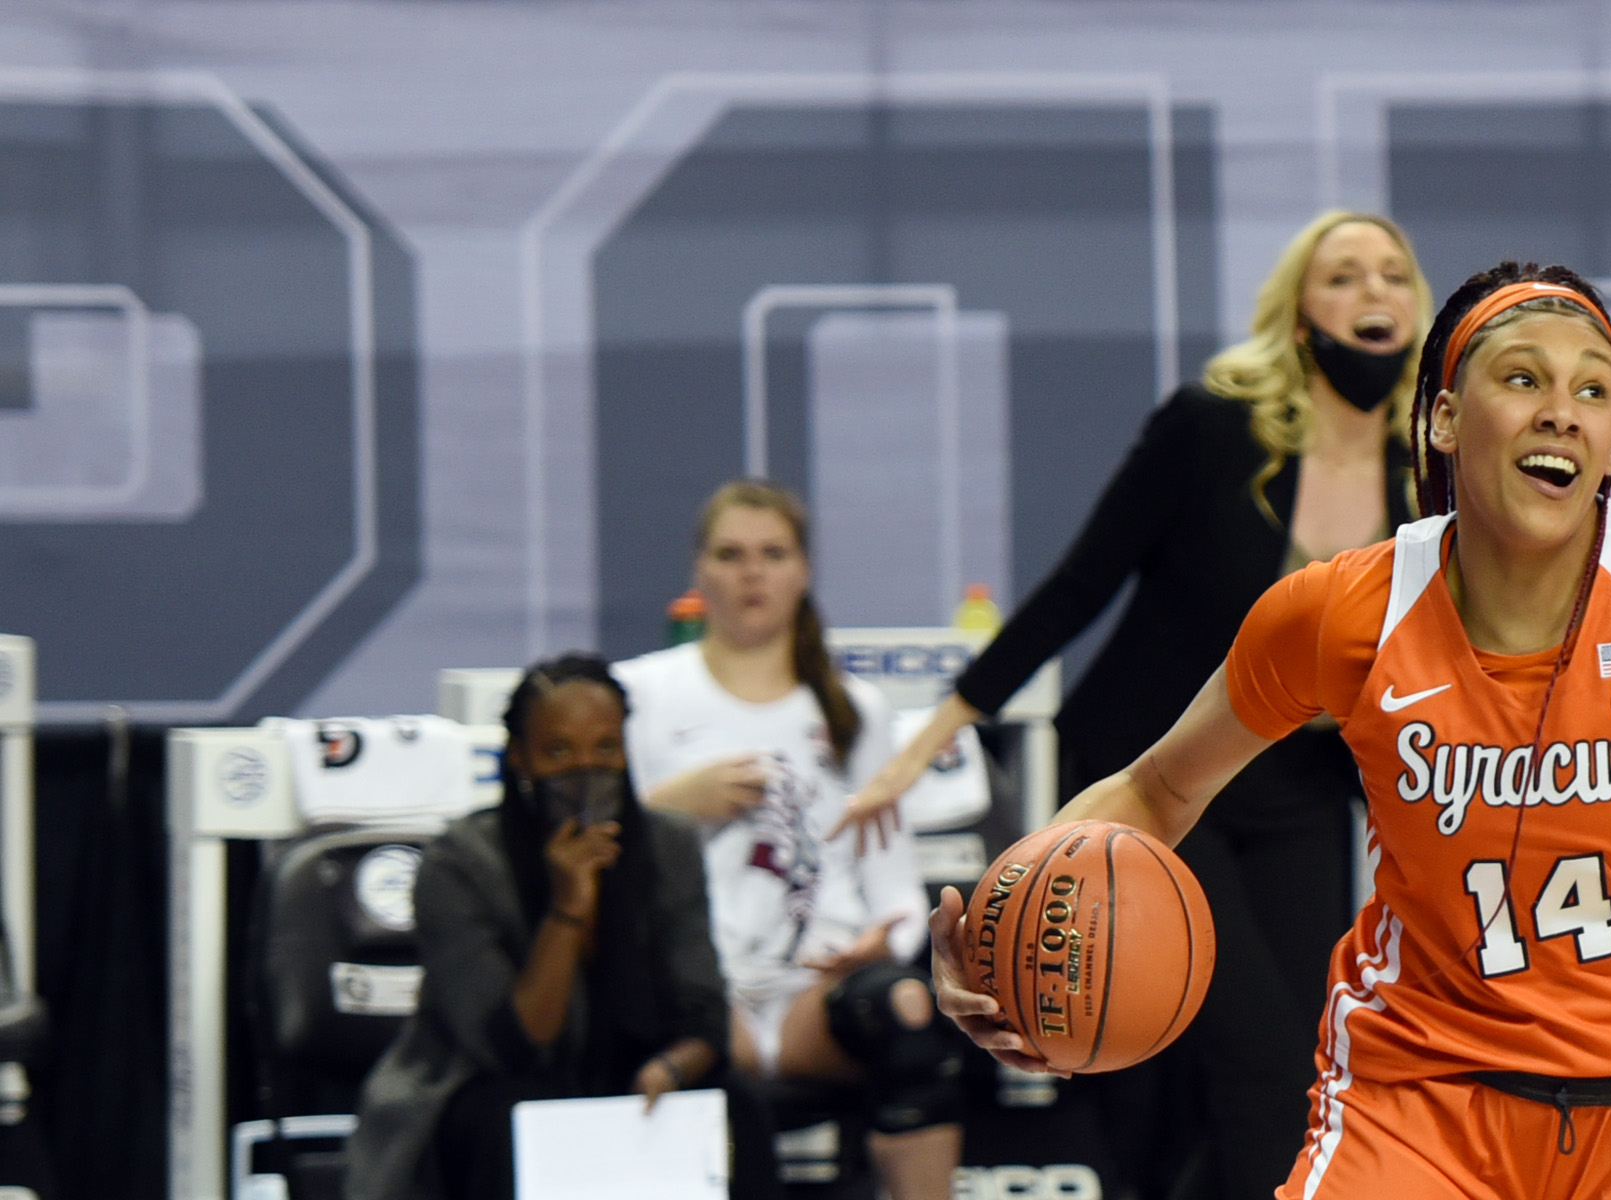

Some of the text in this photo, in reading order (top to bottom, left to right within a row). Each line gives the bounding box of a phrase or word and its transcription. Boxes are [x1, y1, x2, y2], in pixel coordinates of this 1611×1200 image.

[838, 644, 976, 676] EICO
[978, 863, 1032, 1026] ALDING
[1039, 873, 1078, 1037] TF-1000
[1066, 928, 1083, 994] LEGACY
[1083, 901, 1102, 1017] DEEP CHANNEL DESIGN
